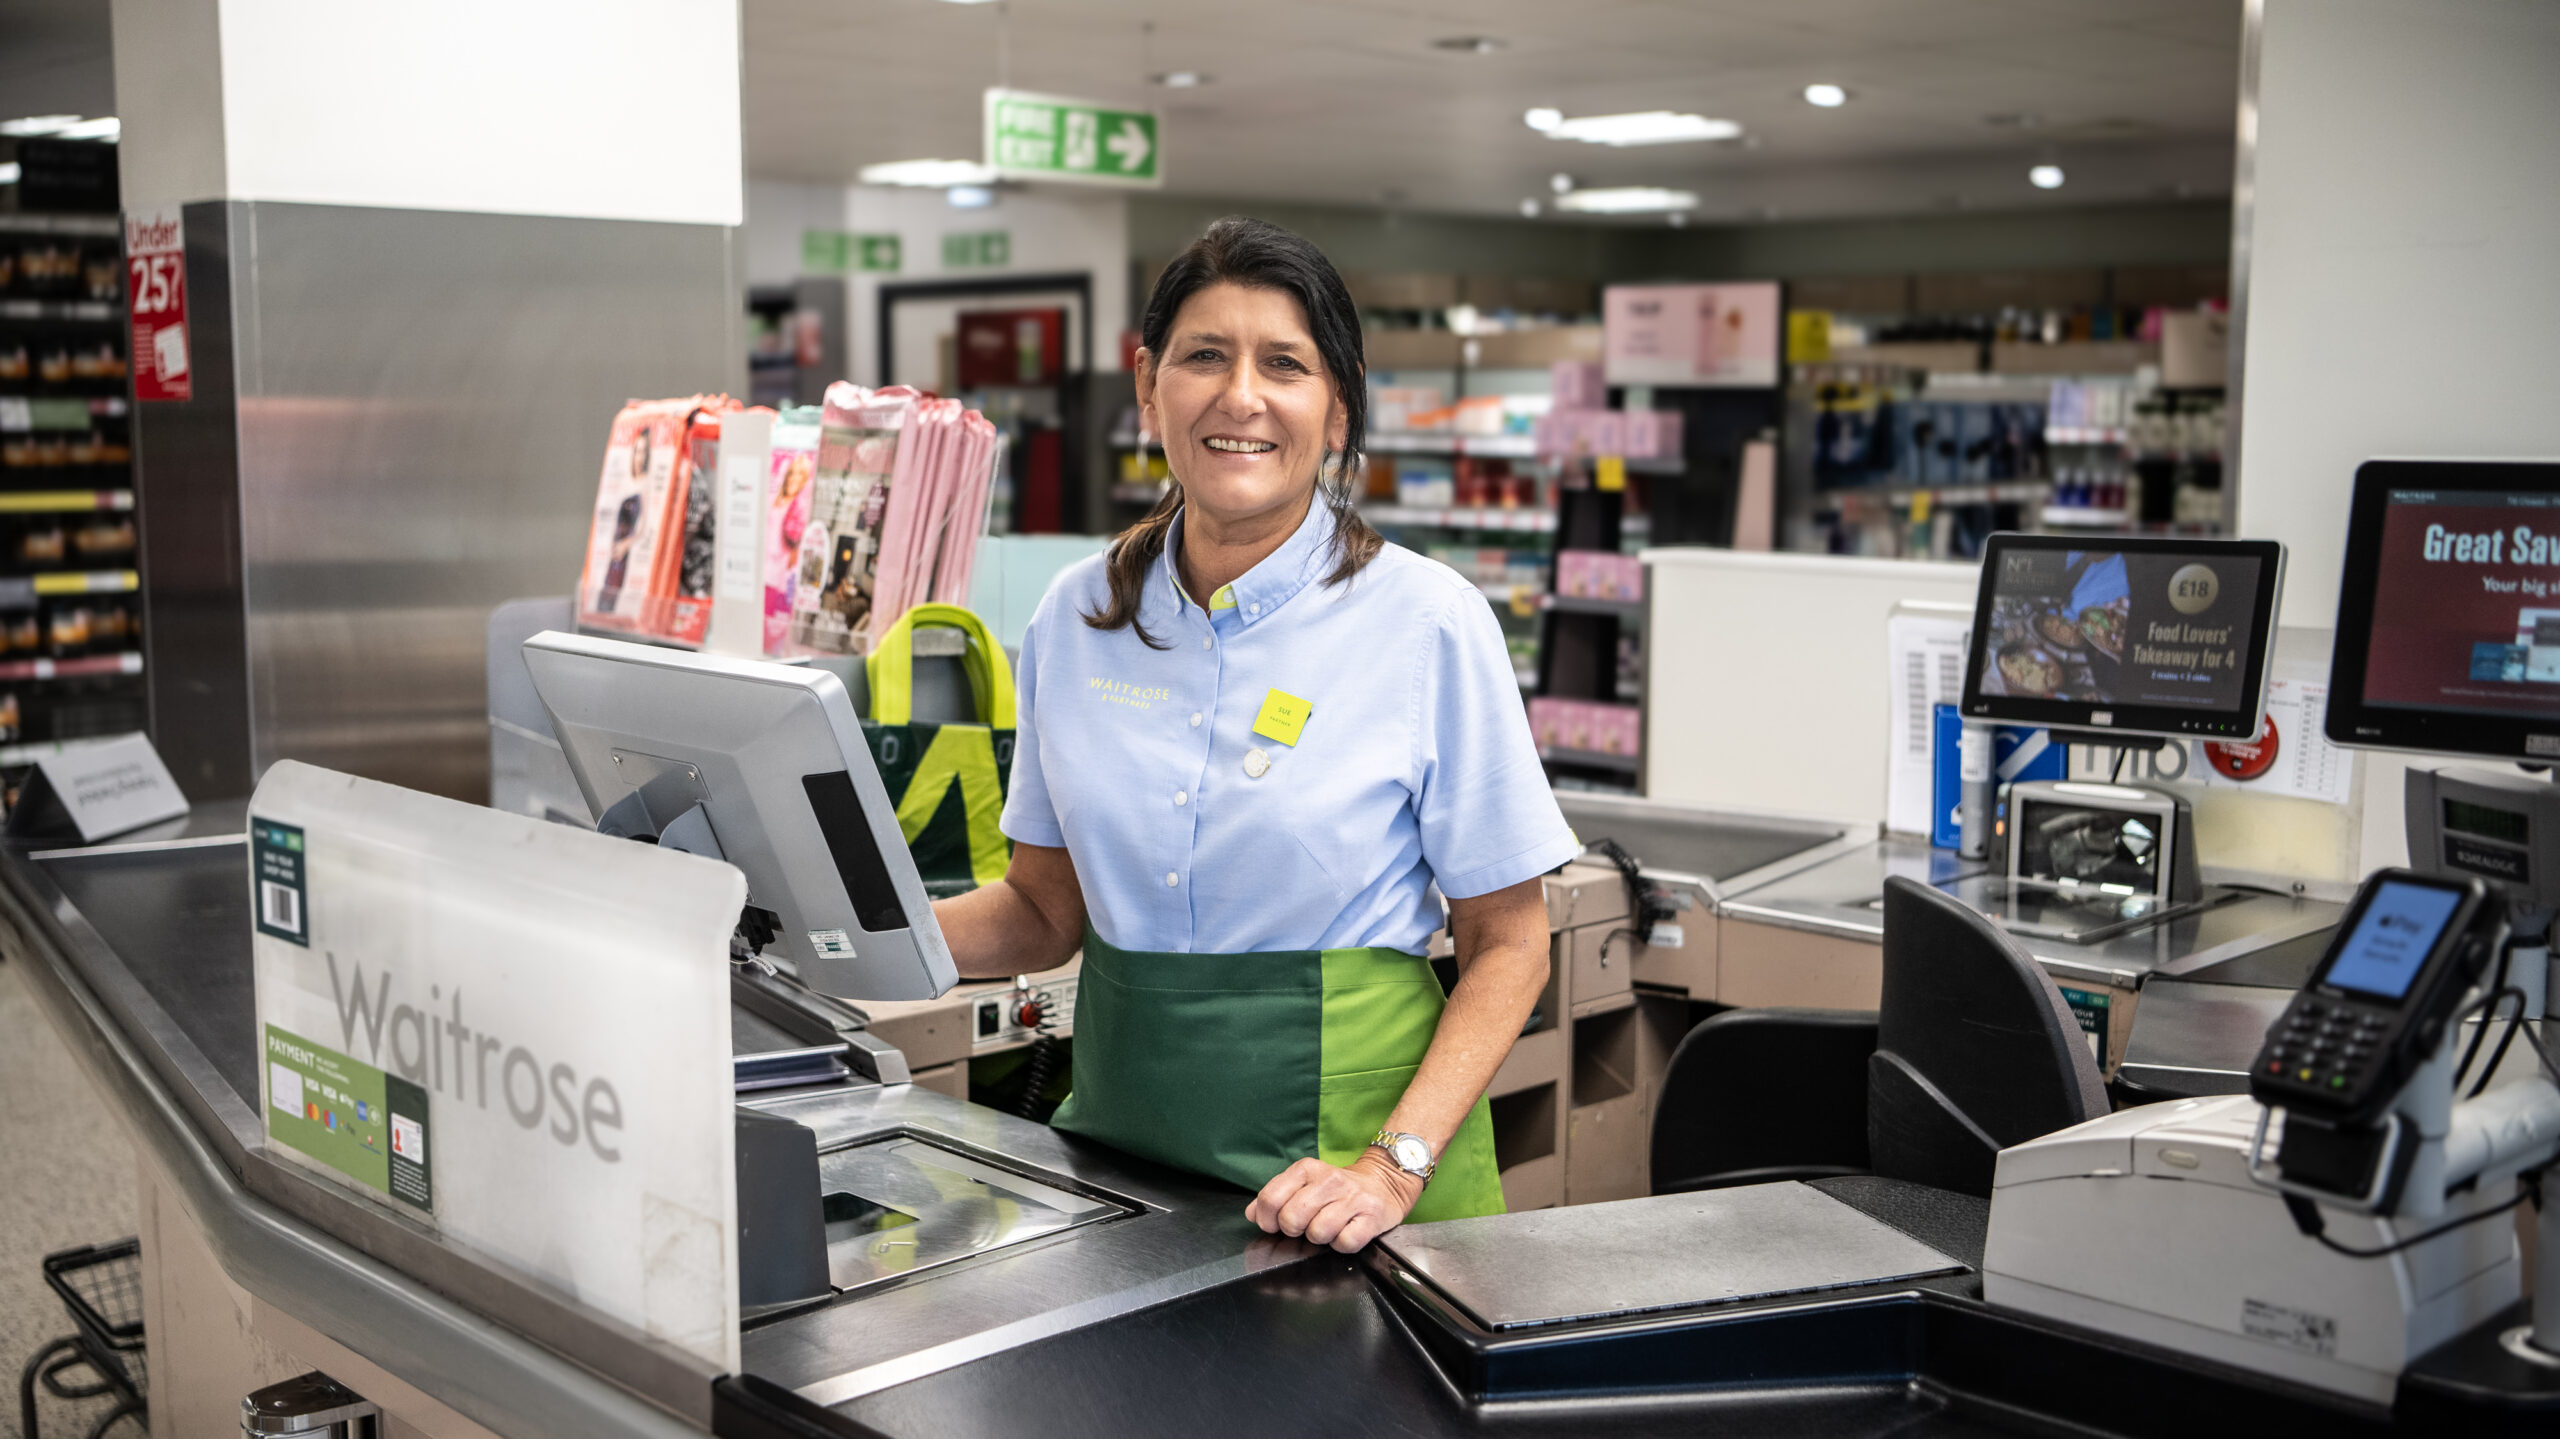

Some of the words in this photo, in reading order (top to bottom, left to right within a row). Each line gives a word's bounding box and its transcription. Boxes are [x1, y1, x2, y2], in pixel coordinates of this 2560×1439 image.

[127, 212, 177, 248] Under
[2423, 522, 2505, 564] Great
[2177, 579, 2210, 598] £18
[2482, 576, 2518, 592] Your
[2521, 577, 2547, 598] big
[2147, 621, 2181, 643] Food
[2182, 622, 2233, 645] Lovers'
[2133, 643, 2199, 671] Takeaway
[2202, 649, 2223, 669] for
[2225, 649, 2236, 670] 4
[1090, 677, 1170, 701] WAITROSE
[1268, 715, 1292, 727] PARTNER
[1277, 705, 1292, 717] SUE
[2080, 1018, 2095, 1028] ERE
[269, 1035, 316, 1068] PAYMENT
[326, 951, 624, 1165] Waitrose
[304, 1076, 320, 1092] VISA
[321, 1084, 338, 1100] VISA
